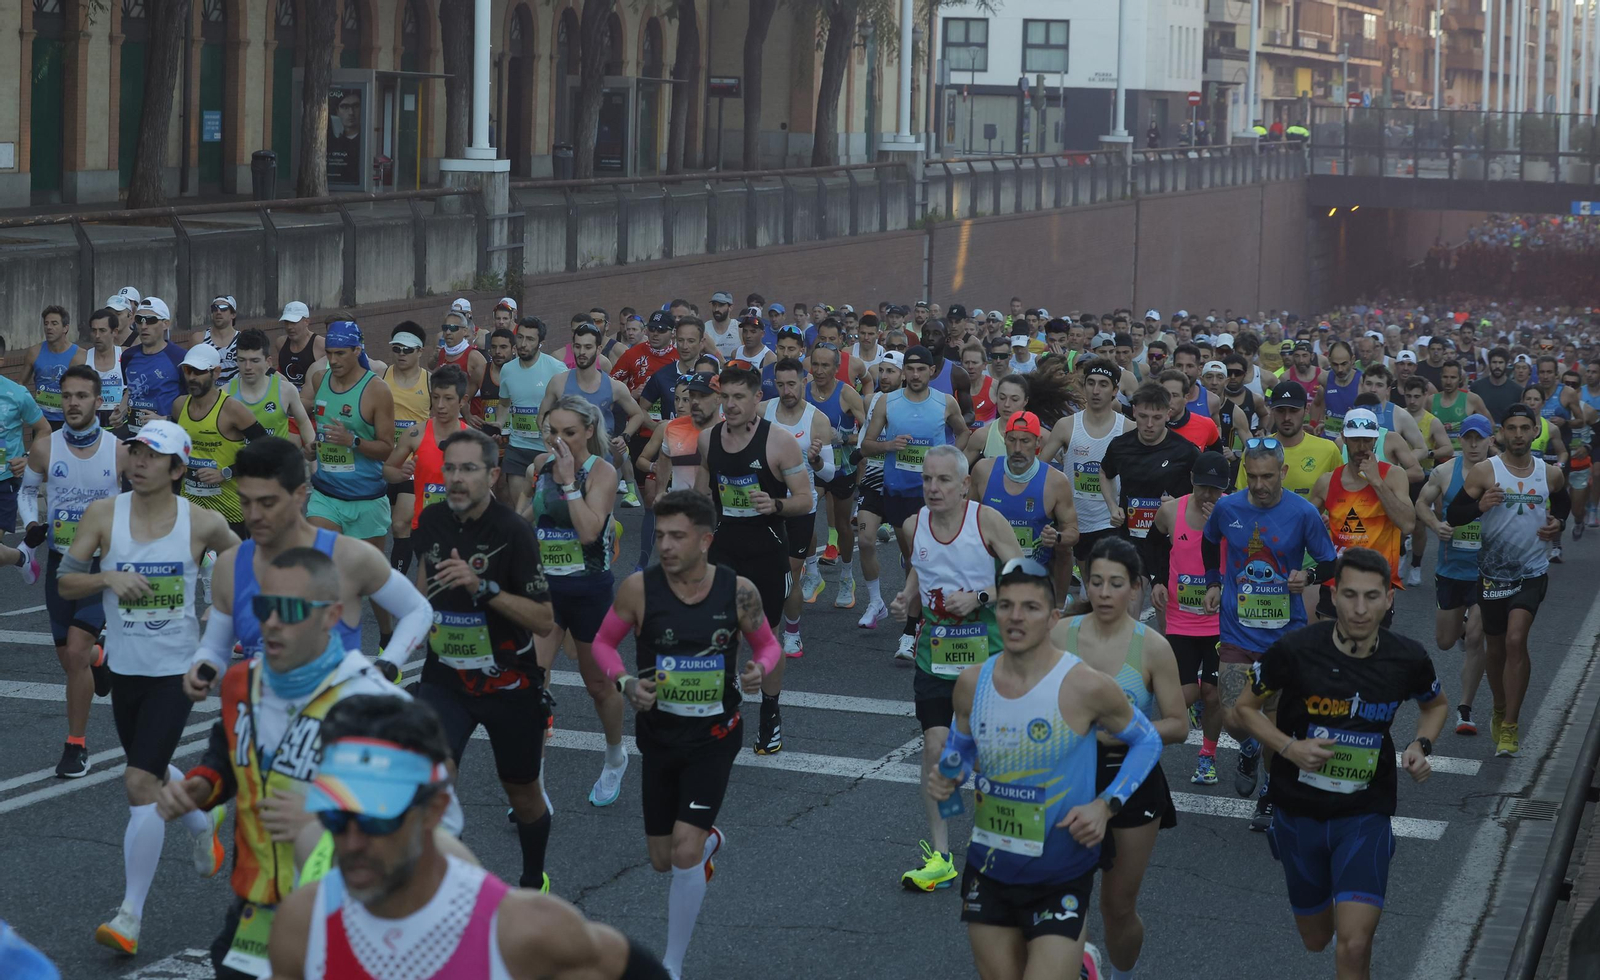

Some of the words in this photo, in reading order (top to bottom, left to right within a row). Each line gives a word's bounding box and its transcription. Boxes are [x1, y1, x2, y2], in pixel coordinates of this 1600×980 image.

[1091, 367, 1113, 377] KAOS
[516, 423, 532, 431] DAVID
[322, 452, 347, 463] SÉRGIO
[191, 459, 212, 467] ZURICH
[729, 477, 753, 486] ZURICH
[72, 487, 110, 497] CALIFATO
[731, 496, 749, 507] JÉJÉ
[543, 552, 572, 564] PROTO
[139, 565, 176, 574] ZURICH
[1178, 596, 1202, 604] JUAN
[1244, 608, 1284, 618] VALERIA
[445, 615, 477, 625] ZURICH
[949, 627, 981, 636] ZURICH
[441, 643, 478, 656] JORGE
[945, 652, 975, 663] KEITH
[679, 659, 717, 669] ZURICH
[680, 678, 701, 686] 2532
[662, 686, 719, 702] VÁZQUEZ
[1358, 701, 1399, 722] LIBRE
[1333, 732, 1374, 747] ZURICH
[1330, 765, 1376, 780] ESTACA
[994, 788, 1036, 801] ZURICH
[996, 805, 1016, 817] 1831
[989, 816, 1024, 836] 11/11
